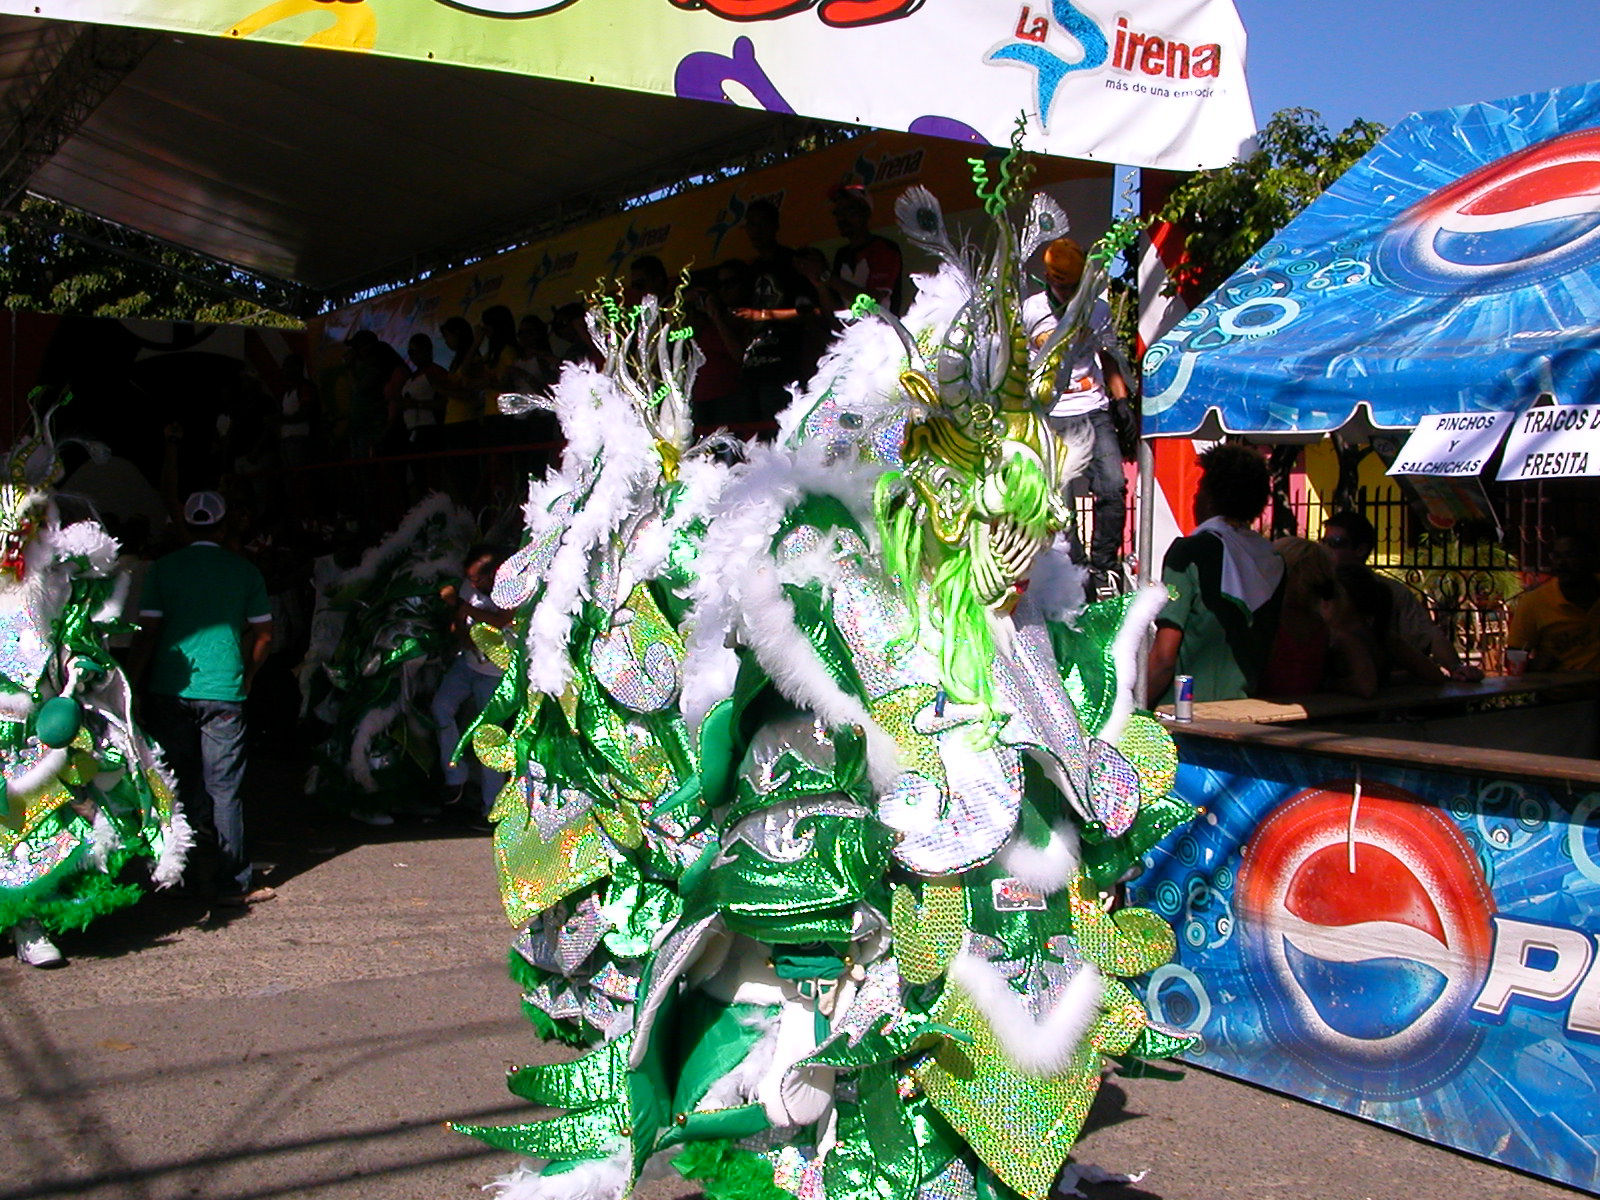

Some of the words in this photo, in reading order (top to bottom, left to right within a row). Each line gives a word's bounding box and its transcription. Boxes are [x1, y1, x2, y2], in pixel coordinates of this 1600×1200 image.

[1015, 6, 1049, 43] La
[1105, 78, 1129, 92] más
[1132, 82, 1147, 94] de
[1150, 86, 1170, 98] una
[1436, 415, 1496, 431] PINCHOS
[1523, 408, 1589, 434] TRAGOS
[1449, 440, 1460, 453] Y
[1398, 459, 1482, 473] SALCHICHAS
[1520, 451, 1589, 477] FRESITA
